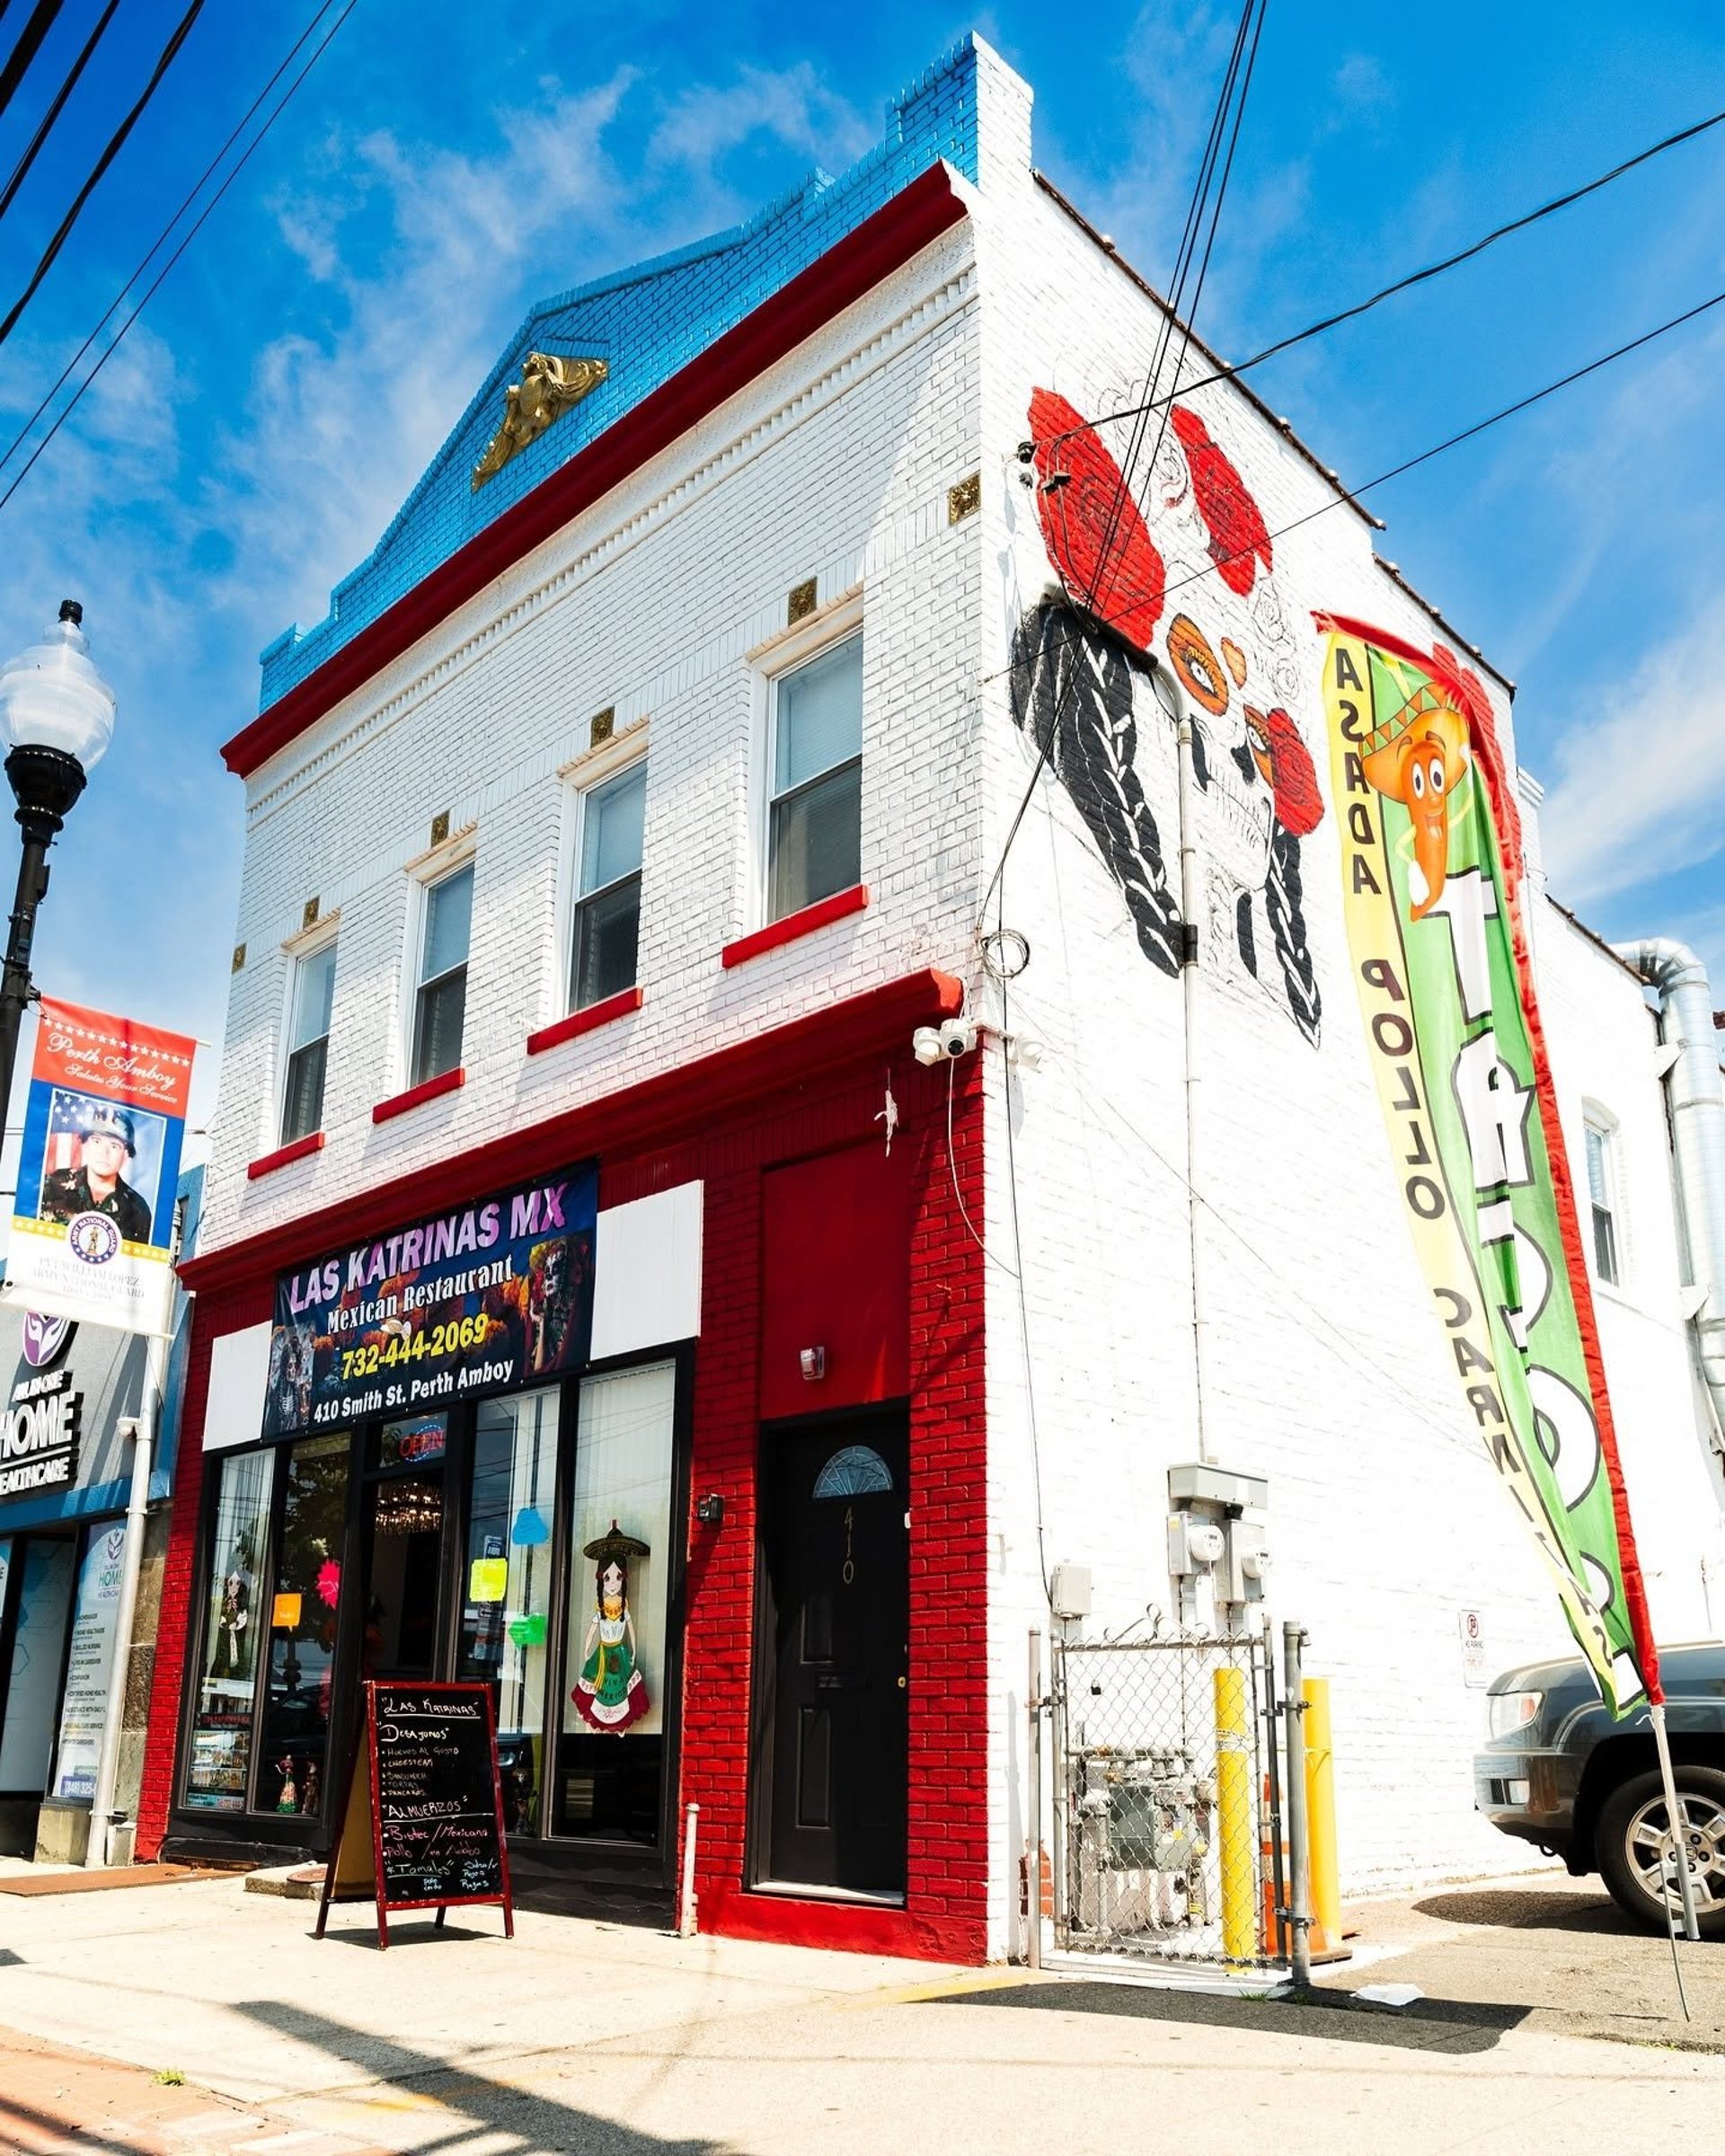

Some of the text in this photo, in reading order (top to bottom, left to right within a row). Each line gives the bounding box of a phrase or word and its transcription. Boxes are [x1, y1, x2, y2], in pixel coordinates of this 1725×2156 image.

[47, 1032, 176, 1091] Perth Amboy
[105, 1074, 139, 1092] Your
[139, 1083, 178, 1104] Service
[78, 1217, 110, 1230] NATIONAL
[291, 1183, 569, 1314] LAS KATRINAS MX
[327, 1254, 513, 1335] Mexican Restaurant
[341, 1313, 489, 1381] 732-444-2069
[314, 1358, 514, 1423] 410 Smith St. Perth Amboy
[0, 1390, 75, 1458] HOME
[400, 1429, 444, 1457] OPEN
[0, 1456, 70, 1495] EALTHCARE
